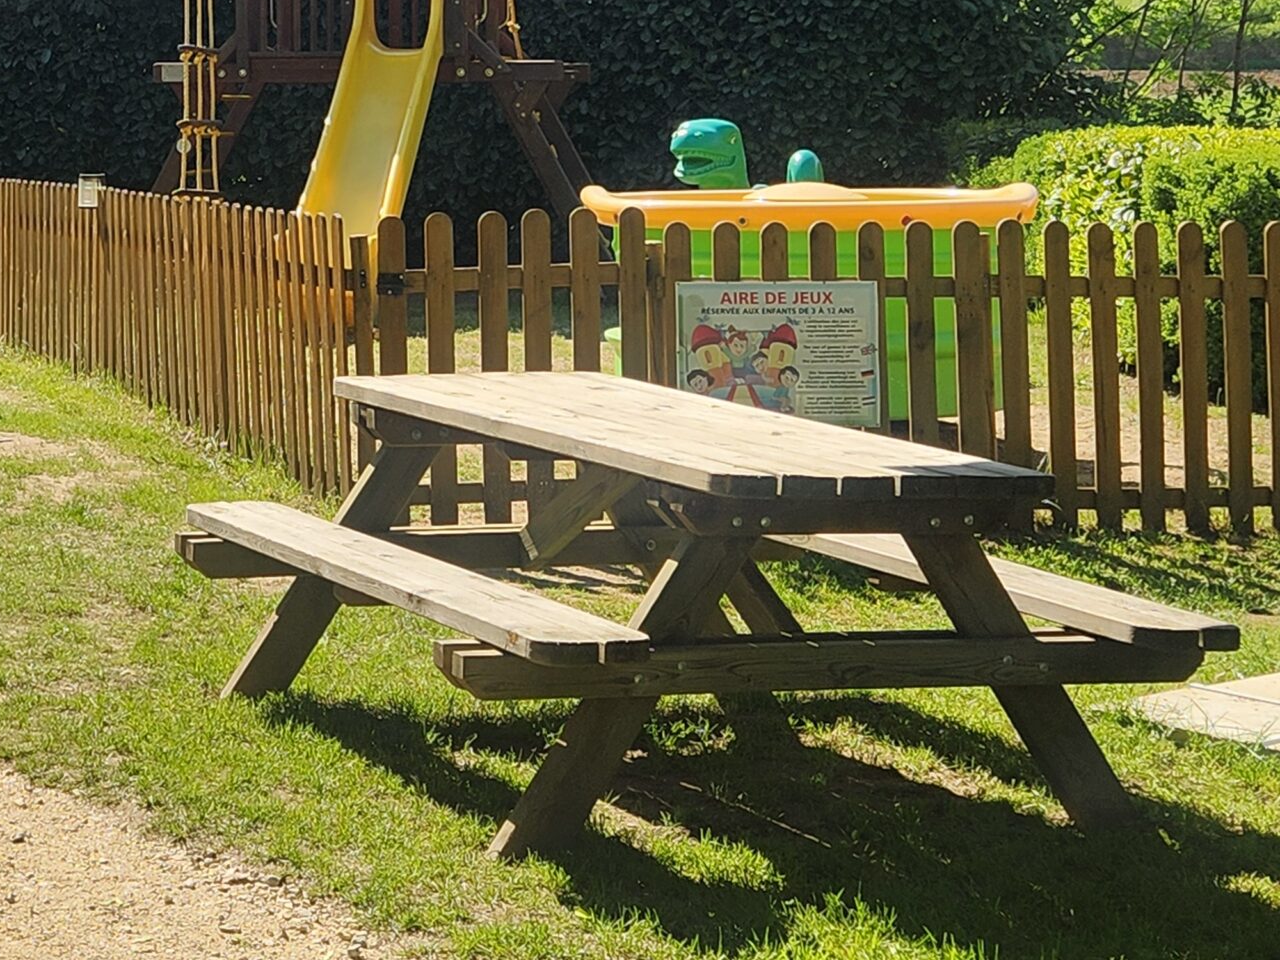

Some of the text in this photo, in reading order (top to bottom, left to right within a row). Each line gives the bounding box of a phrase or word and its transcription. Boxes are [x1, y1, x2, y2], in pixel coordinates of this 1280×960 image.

[720, 291, 834, 305] AIRE DE JEUX
[701, 306, 740, 315] RÉSERVÉE
[838, 307, 855, 315] ANS
